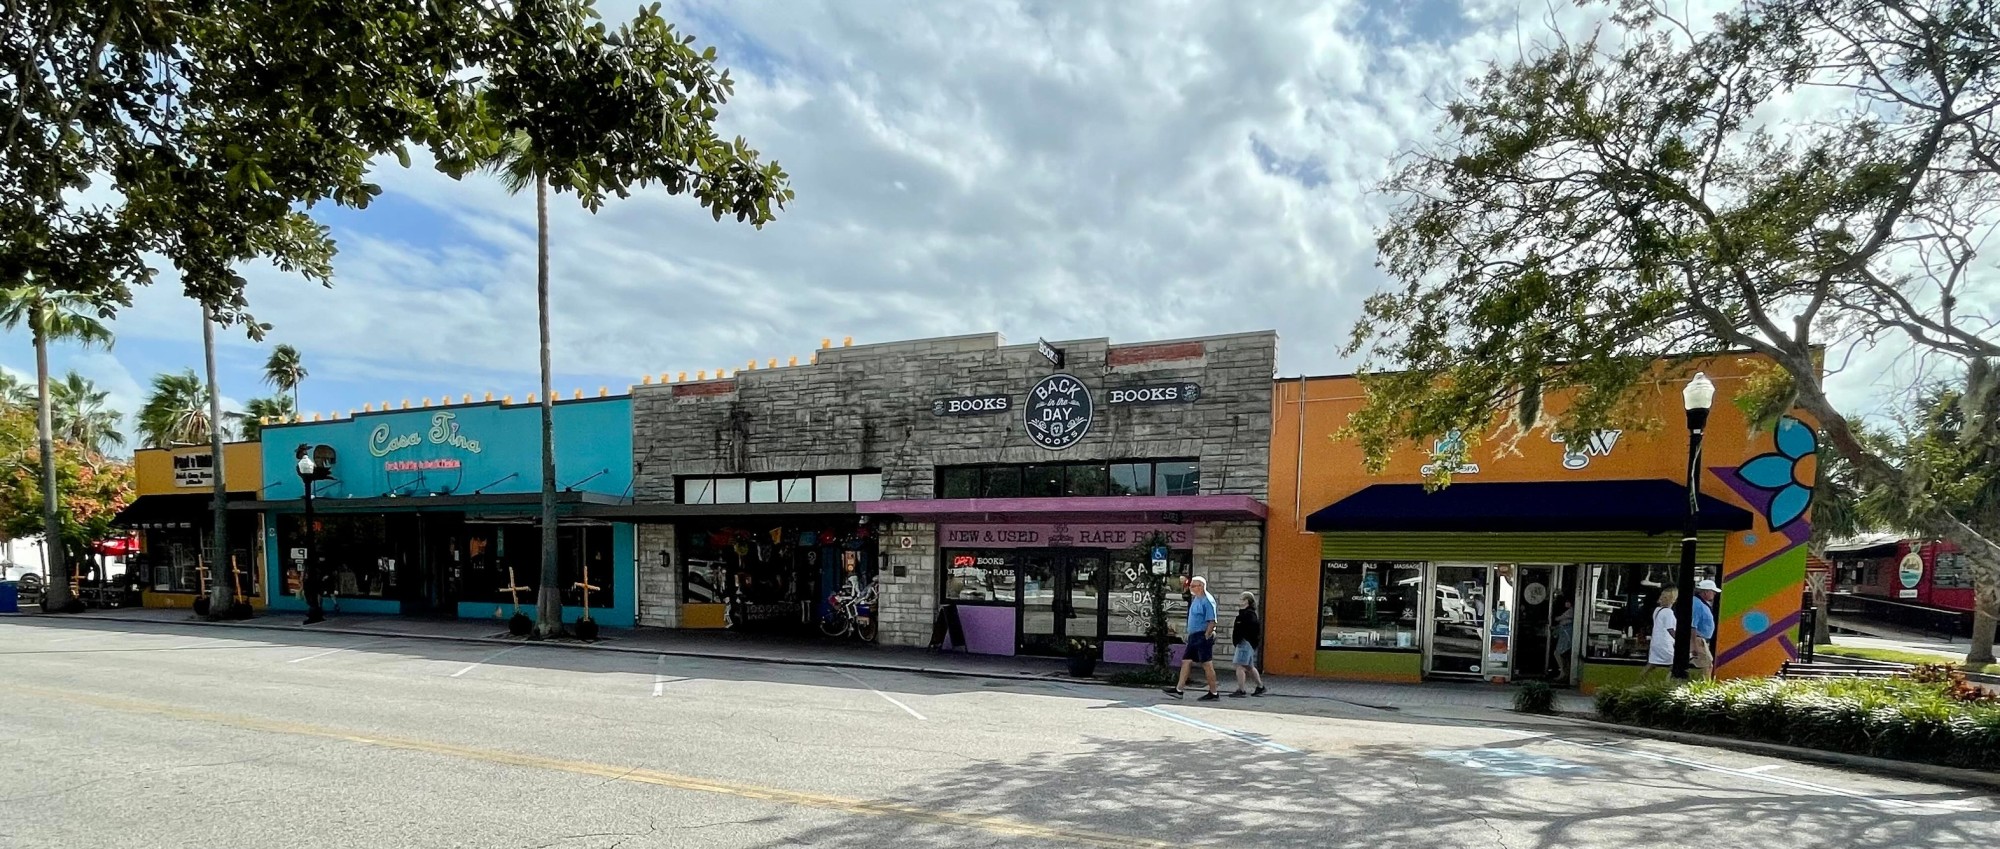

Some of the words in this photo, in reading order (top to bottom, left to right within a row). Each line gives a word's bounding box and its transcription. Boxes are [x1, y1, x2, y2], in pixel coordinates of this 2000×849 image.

[1035, 379, 1080, 400] BACK
[1109, 387, 1178, 403] BOOKS
[948, 398, 1007, 412] BOOKS
[1047, 398, 1055, 407] in
[1056, 397, 1069, 406] the
[1043, 407, 1072, 421] DAY
[369, 423, 421, 457] Casa
[428, 412, 481, 453] Tina
[1036, 430, 1078, 445] BOOKS
[948, 530, 979, 542] NEW
[983, 530, 995, 543] &
[997, 530, 1039, 543] USED
[1080, 530, 1126, 543] RARE
[1132, 530, 1186, 543] BOKS
[954, 556, 976, 566] OPEN
[977, 557, 1005, 565] BOOKS
[1132, 590, 1152, 604] DA
